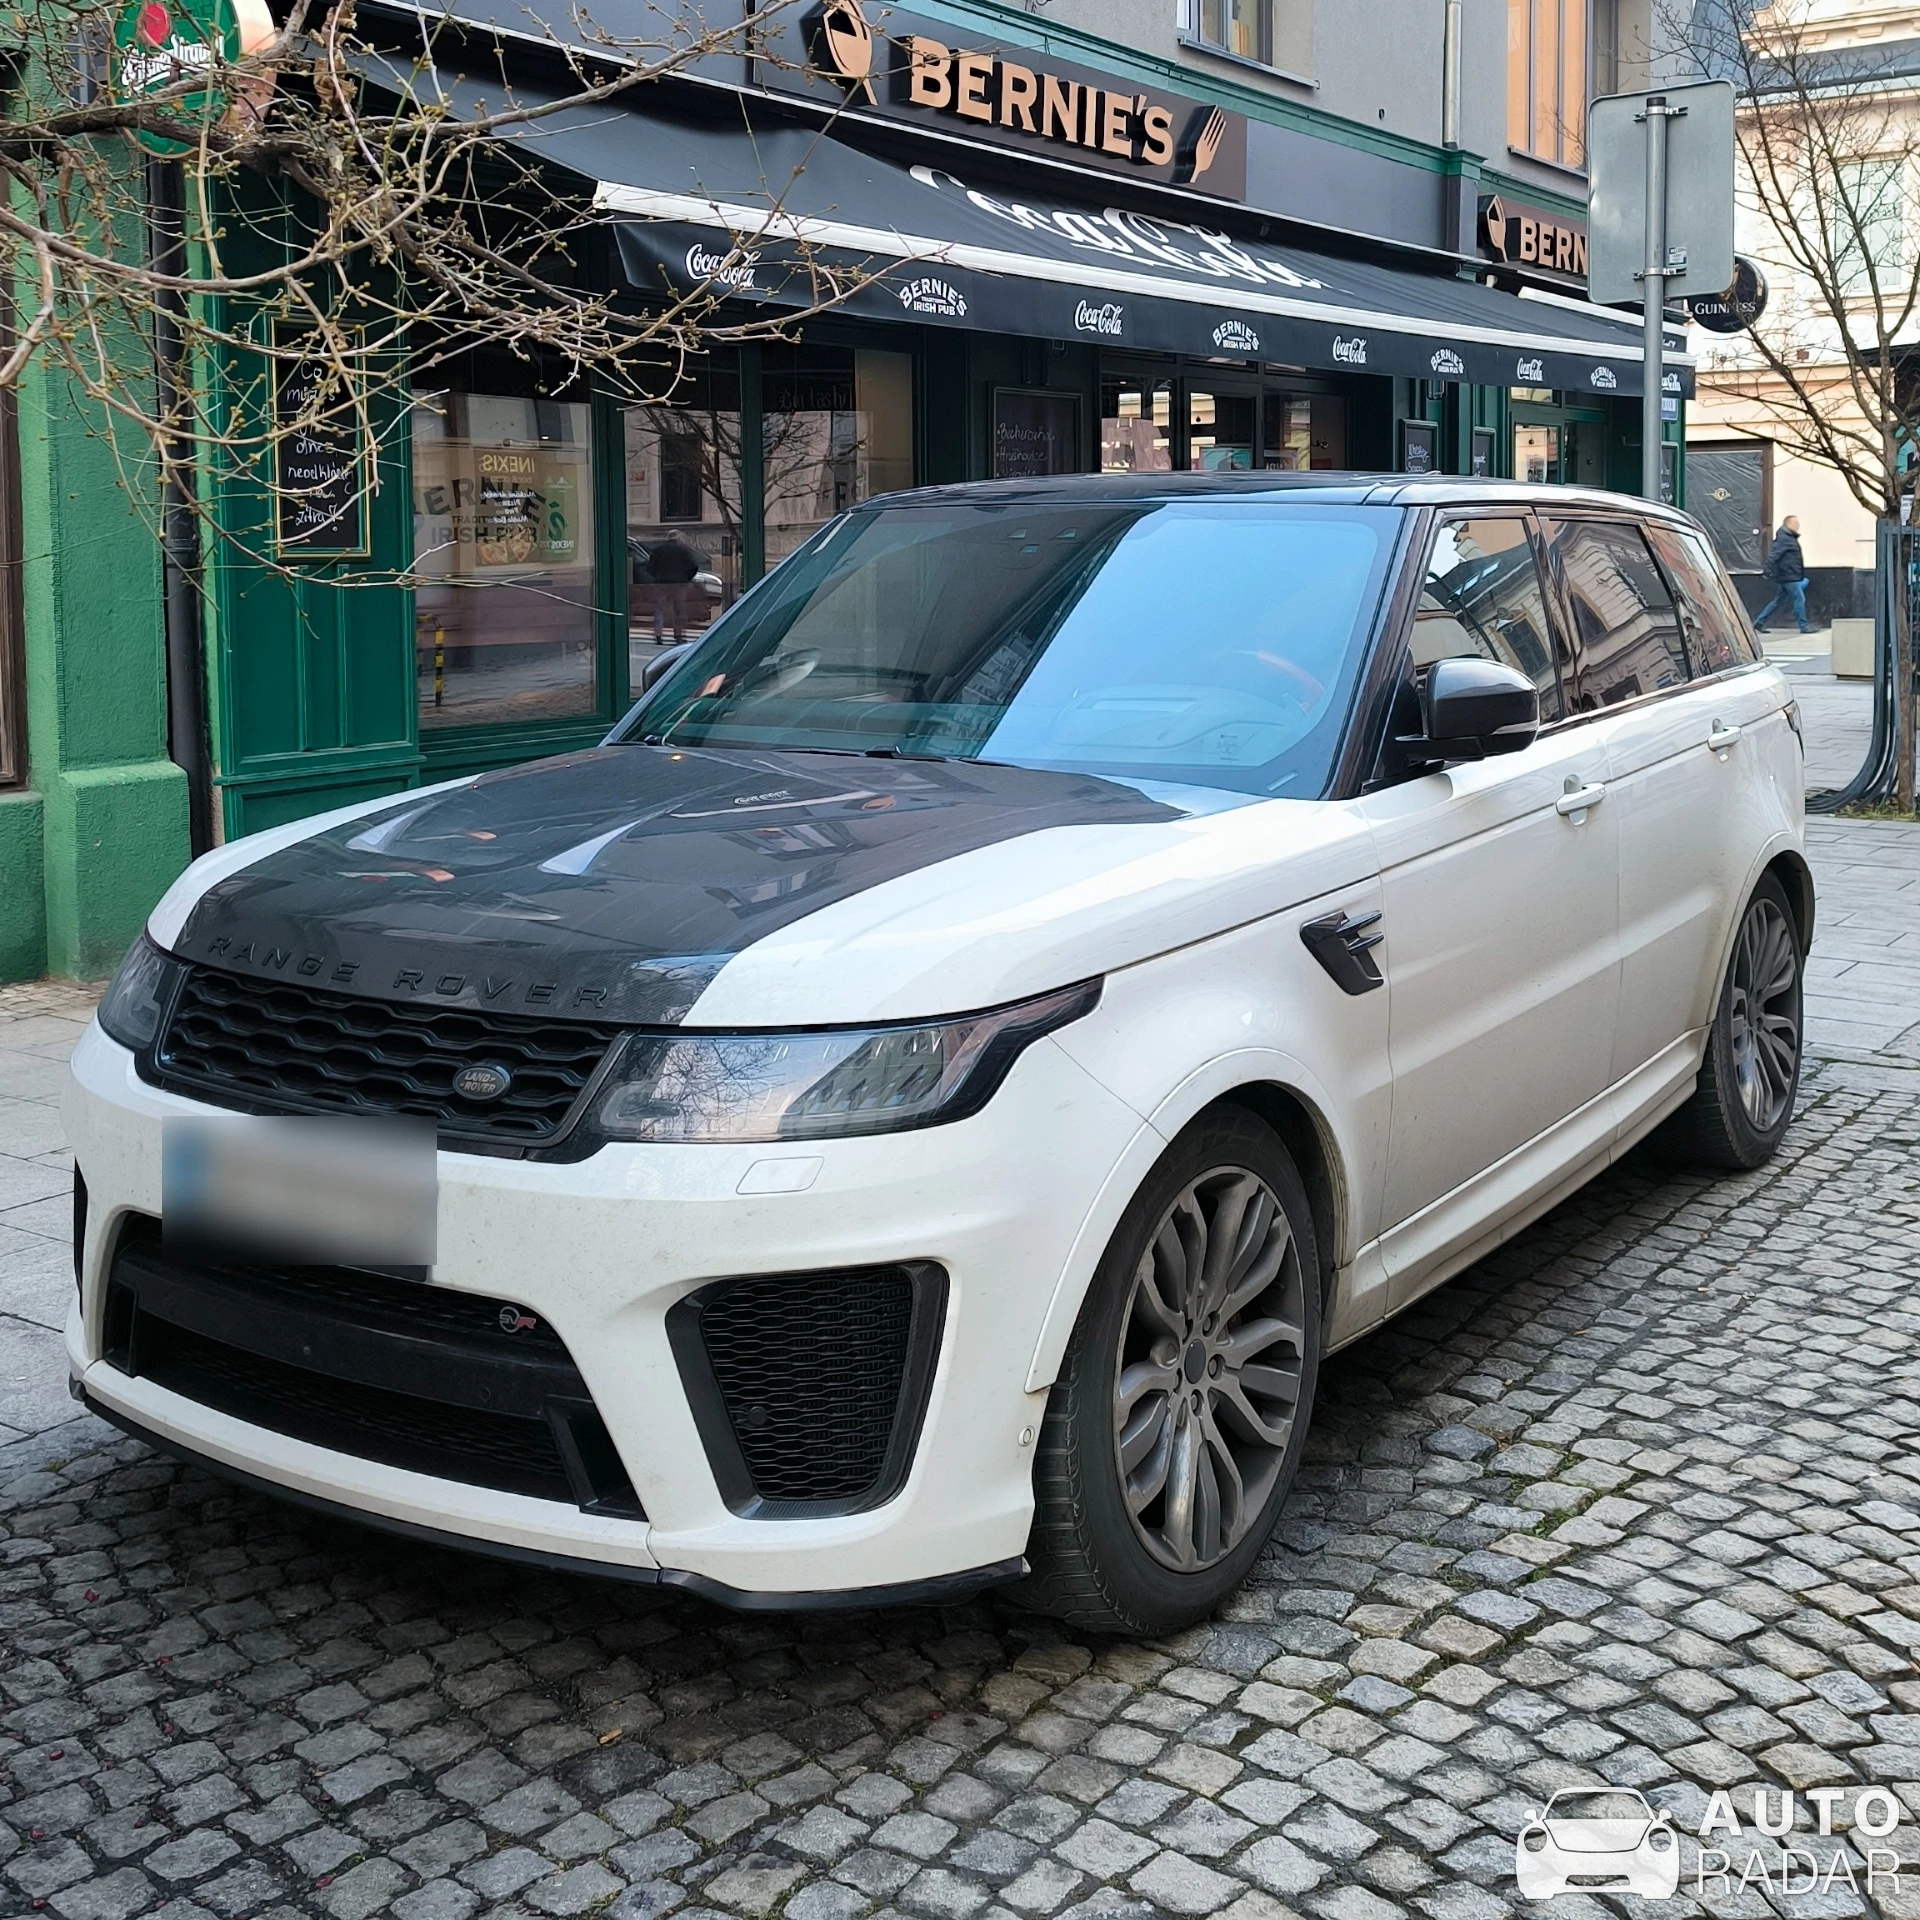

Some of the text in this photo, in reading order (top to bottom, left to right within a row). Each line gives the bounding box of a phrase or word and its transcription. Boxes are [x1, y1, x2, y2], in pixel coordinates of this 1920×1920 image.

[909, 34, 1174, 166] BERNIE'S
[899, 278, 968, 317] BERNIE'S
[913, 300, 937, 314] IRISH
[938, 304, 956, 316] PUB
[1694, 302, 1757, 315] GUINESS
[1075, 299, 1123, 336] Coca-Cola
[1212, 320, 1260, 351] BERNIE'S
[1332, 335, 1367, 365] Coca-Cola
[301, 360, 323, 380] Co
[412, 475, 569, 542] ERNIE'S
[206, 937, 608, 1010] RANGE ROVER
[463, 1081, 497, 1094] ROVER
[464, 1071, 492, 1083] LAND
